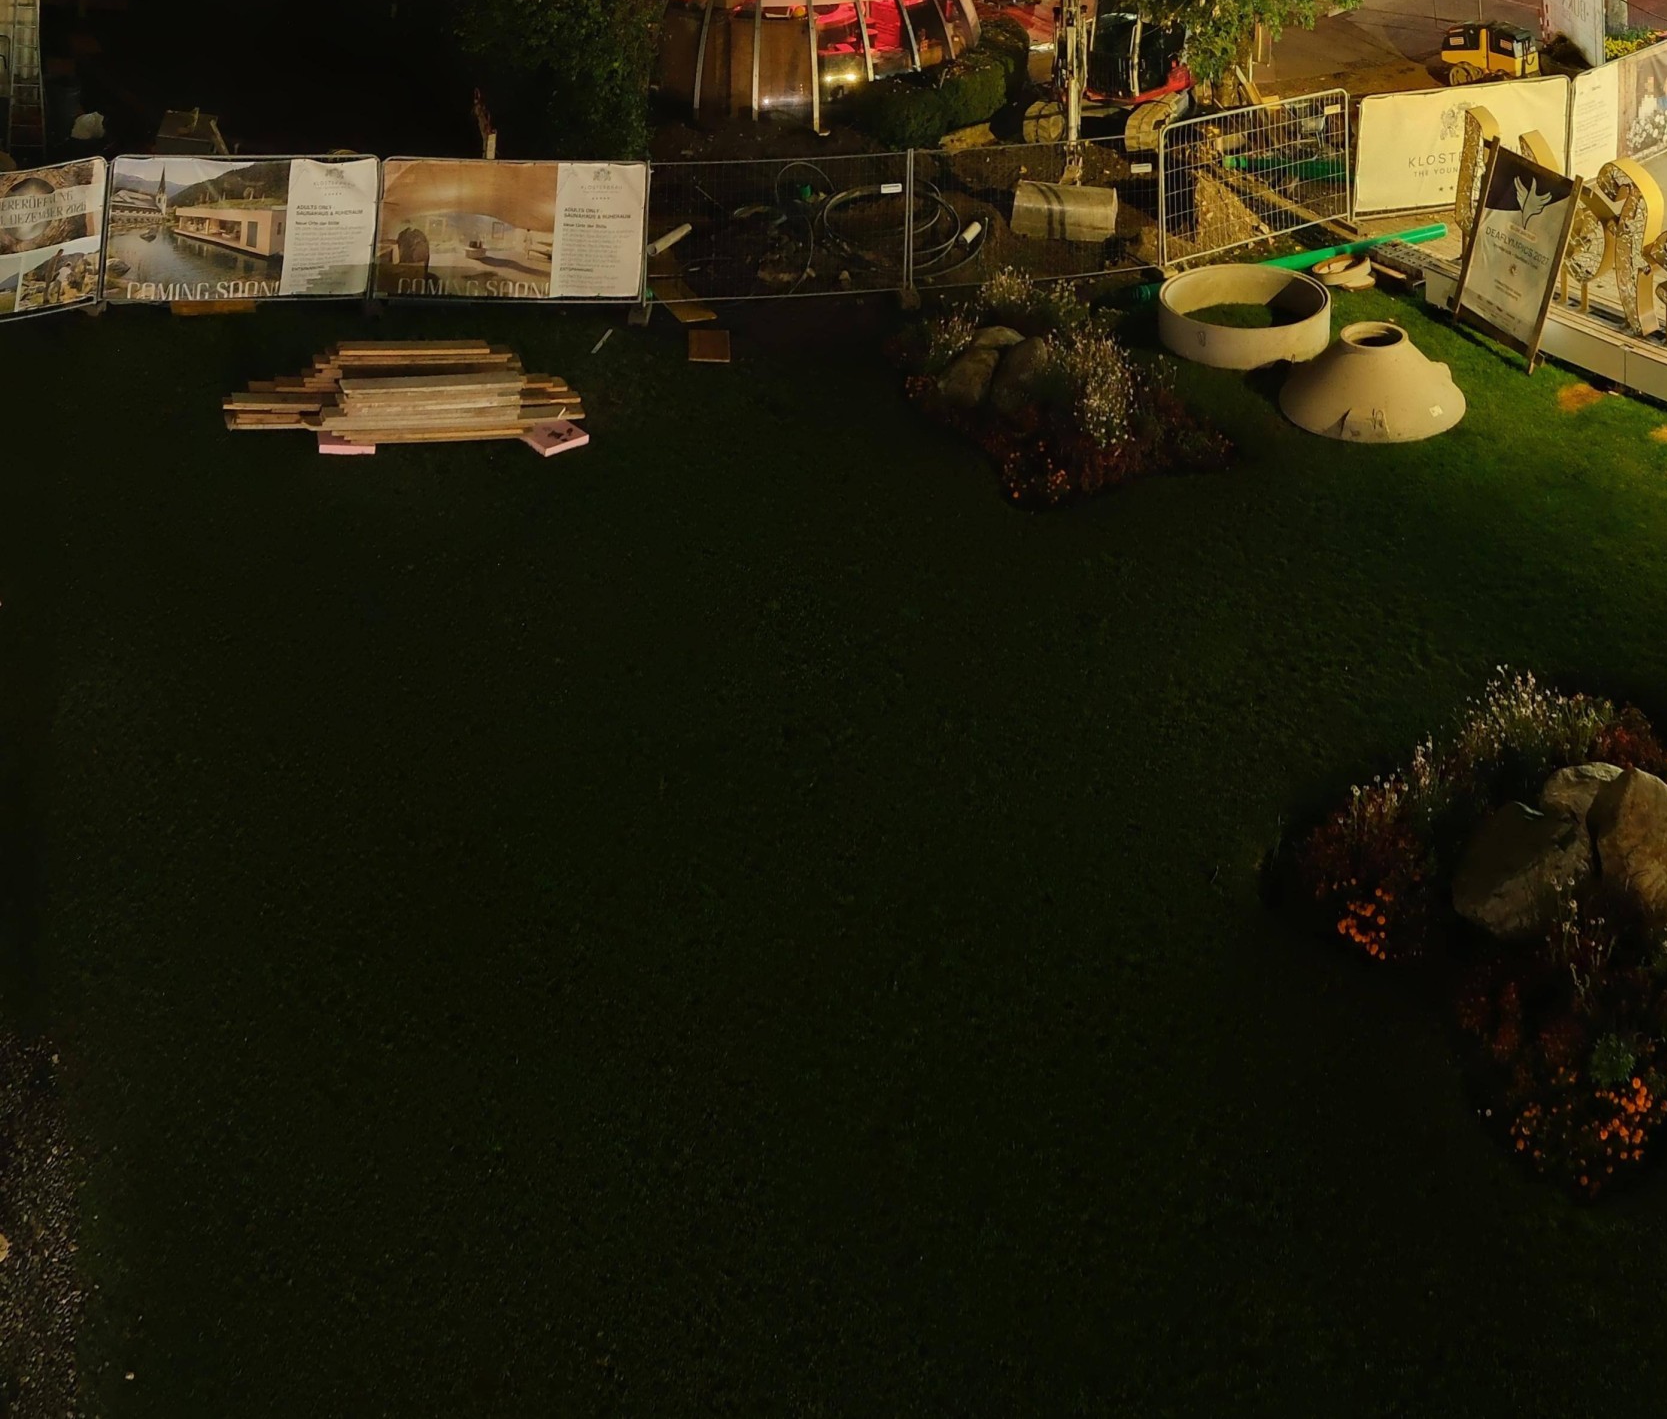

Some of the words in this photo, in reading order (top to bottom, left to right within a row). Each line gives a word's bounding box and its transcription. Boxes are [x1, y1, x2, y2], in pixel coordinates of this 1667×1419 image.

[1434, 167, 1458, 175] YOUN
[126, 281, 209, 300] COMING
[397, 278, 479, 296] COMING
